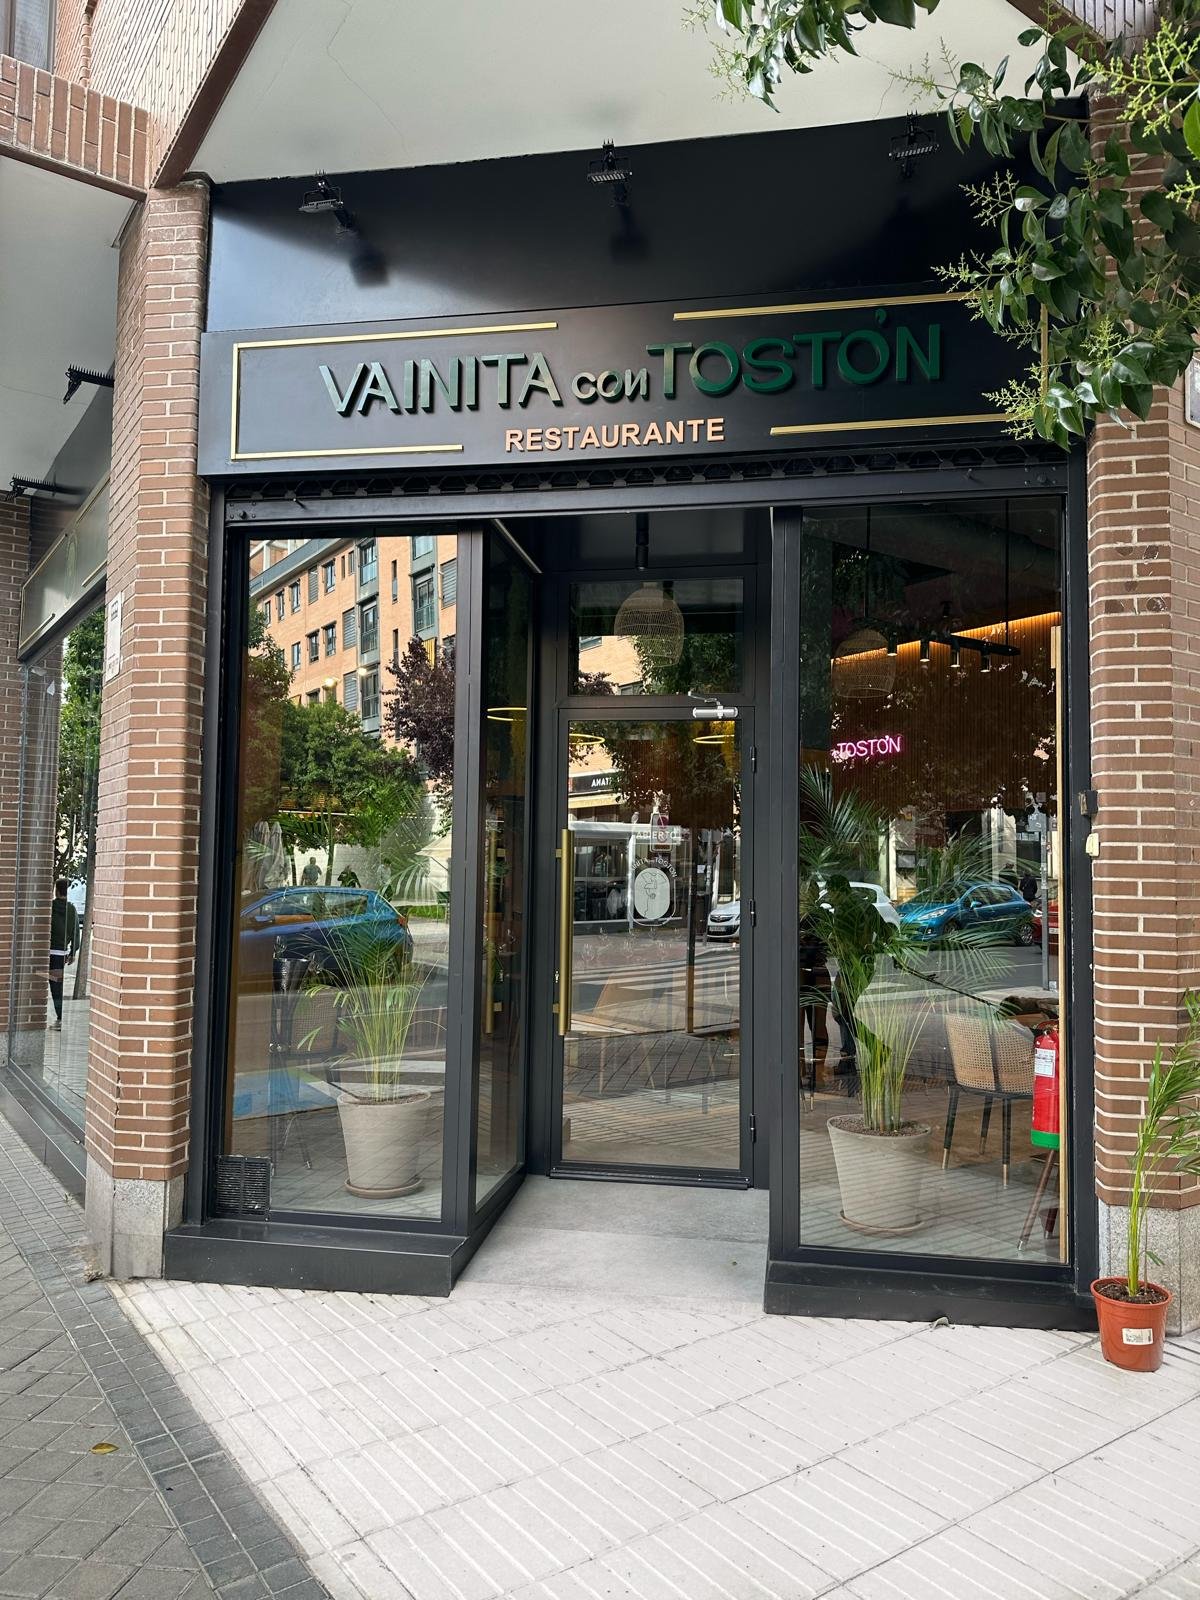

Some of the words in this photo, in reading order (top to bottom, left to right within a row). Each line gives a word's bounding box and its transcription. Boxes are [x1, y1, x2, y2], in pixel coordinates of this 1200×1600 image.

[319, 351, 564, 417] VAINITA
[646, 309, 942, 398] TOSTÓN
[505, 417, 726, 453] RESTAURANTE
